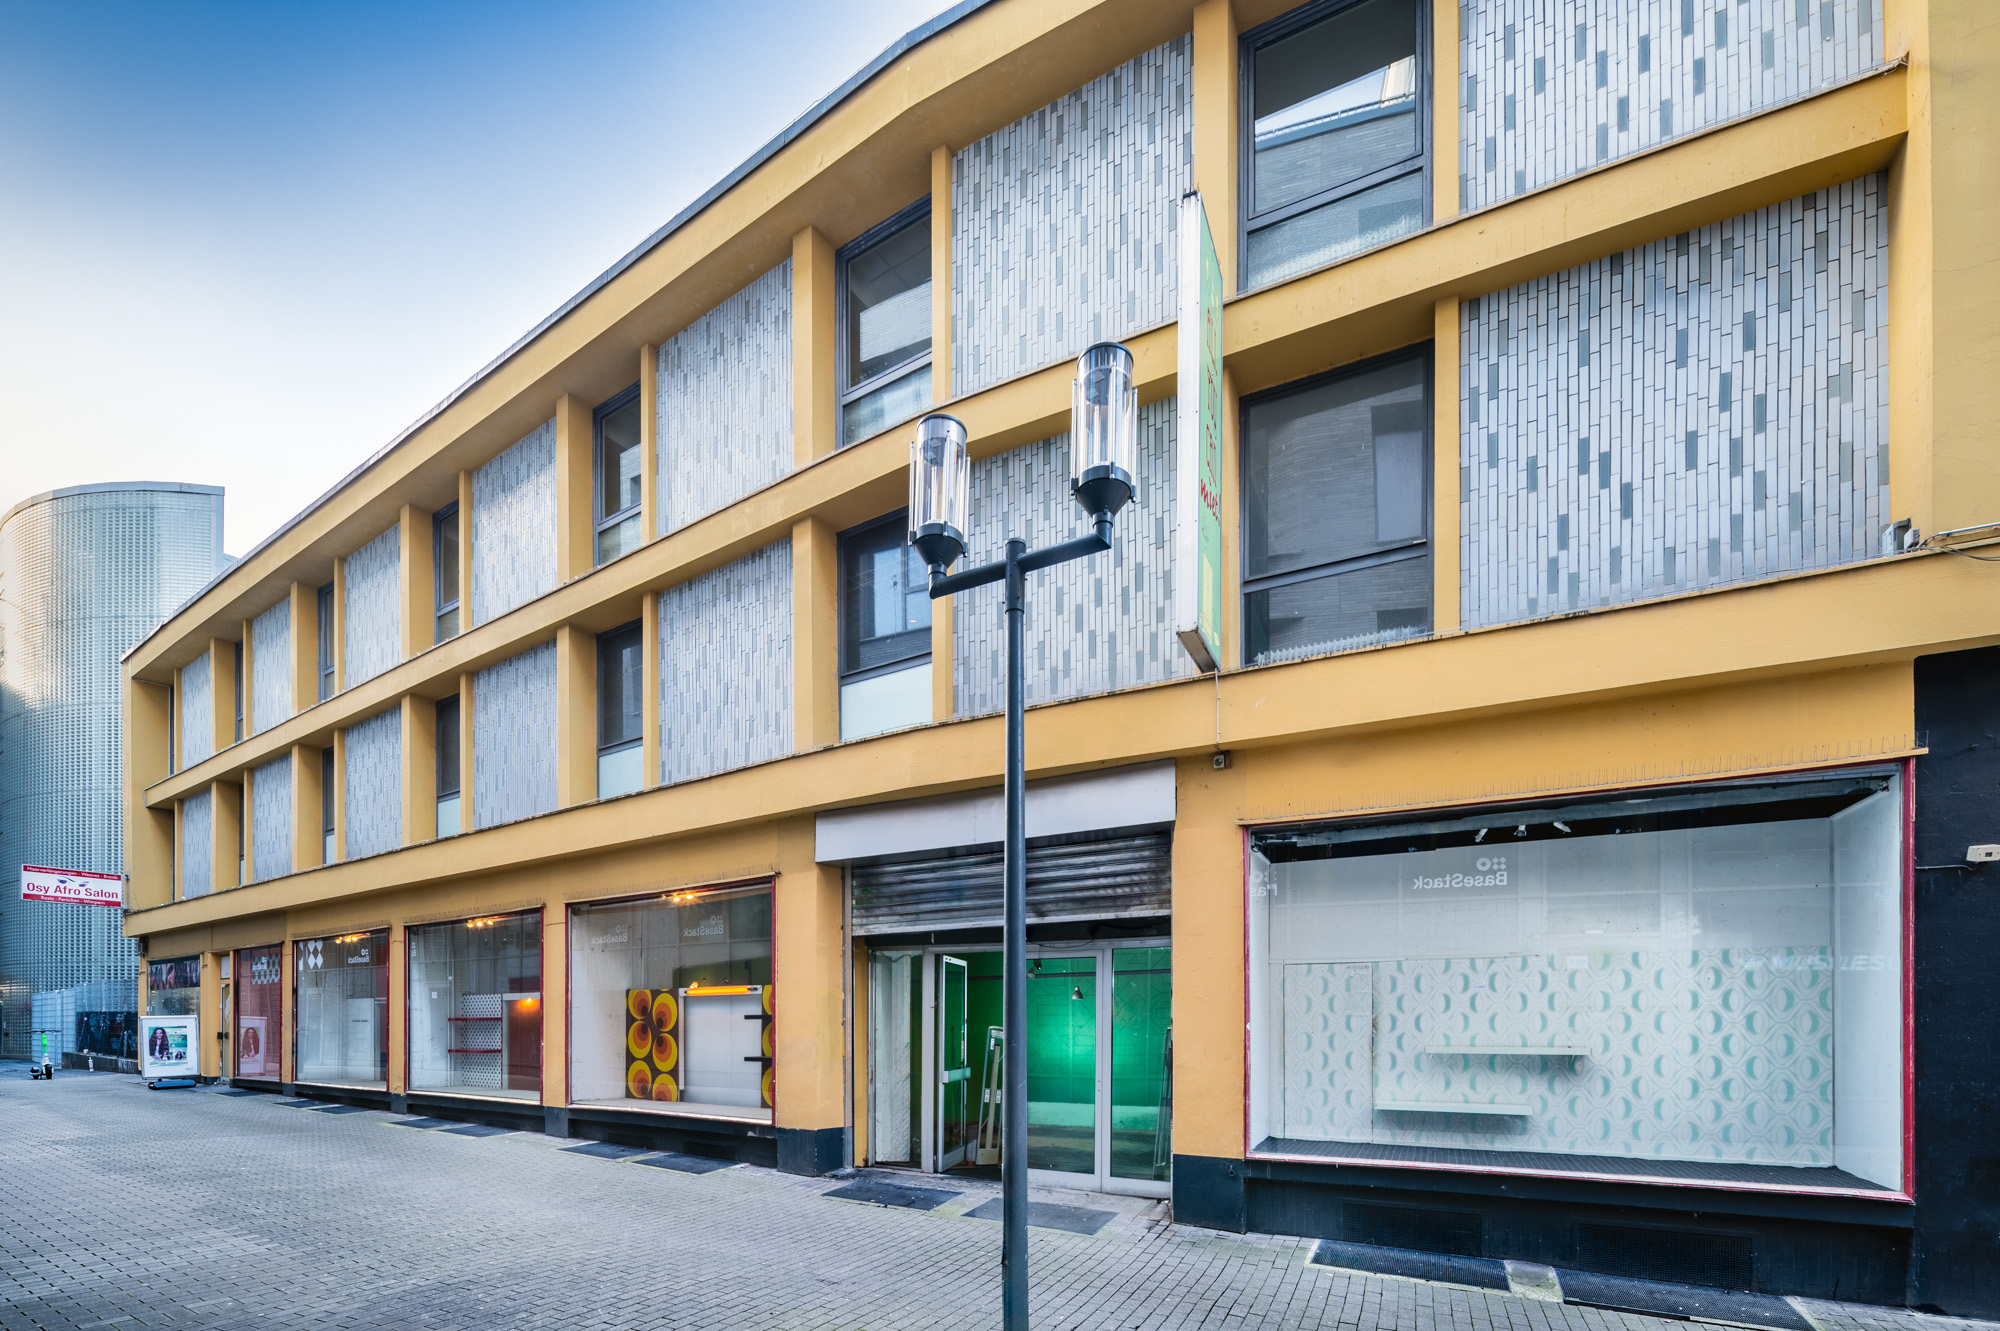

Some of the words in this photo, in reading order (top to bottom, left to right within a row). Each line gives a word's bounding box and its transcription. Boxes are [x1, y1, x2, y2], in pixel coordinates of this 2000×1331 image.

[26, 882, 50, 894] Osy
[54, 885, 81, 895] Afro
[84, 888, 119, 899] Salon
